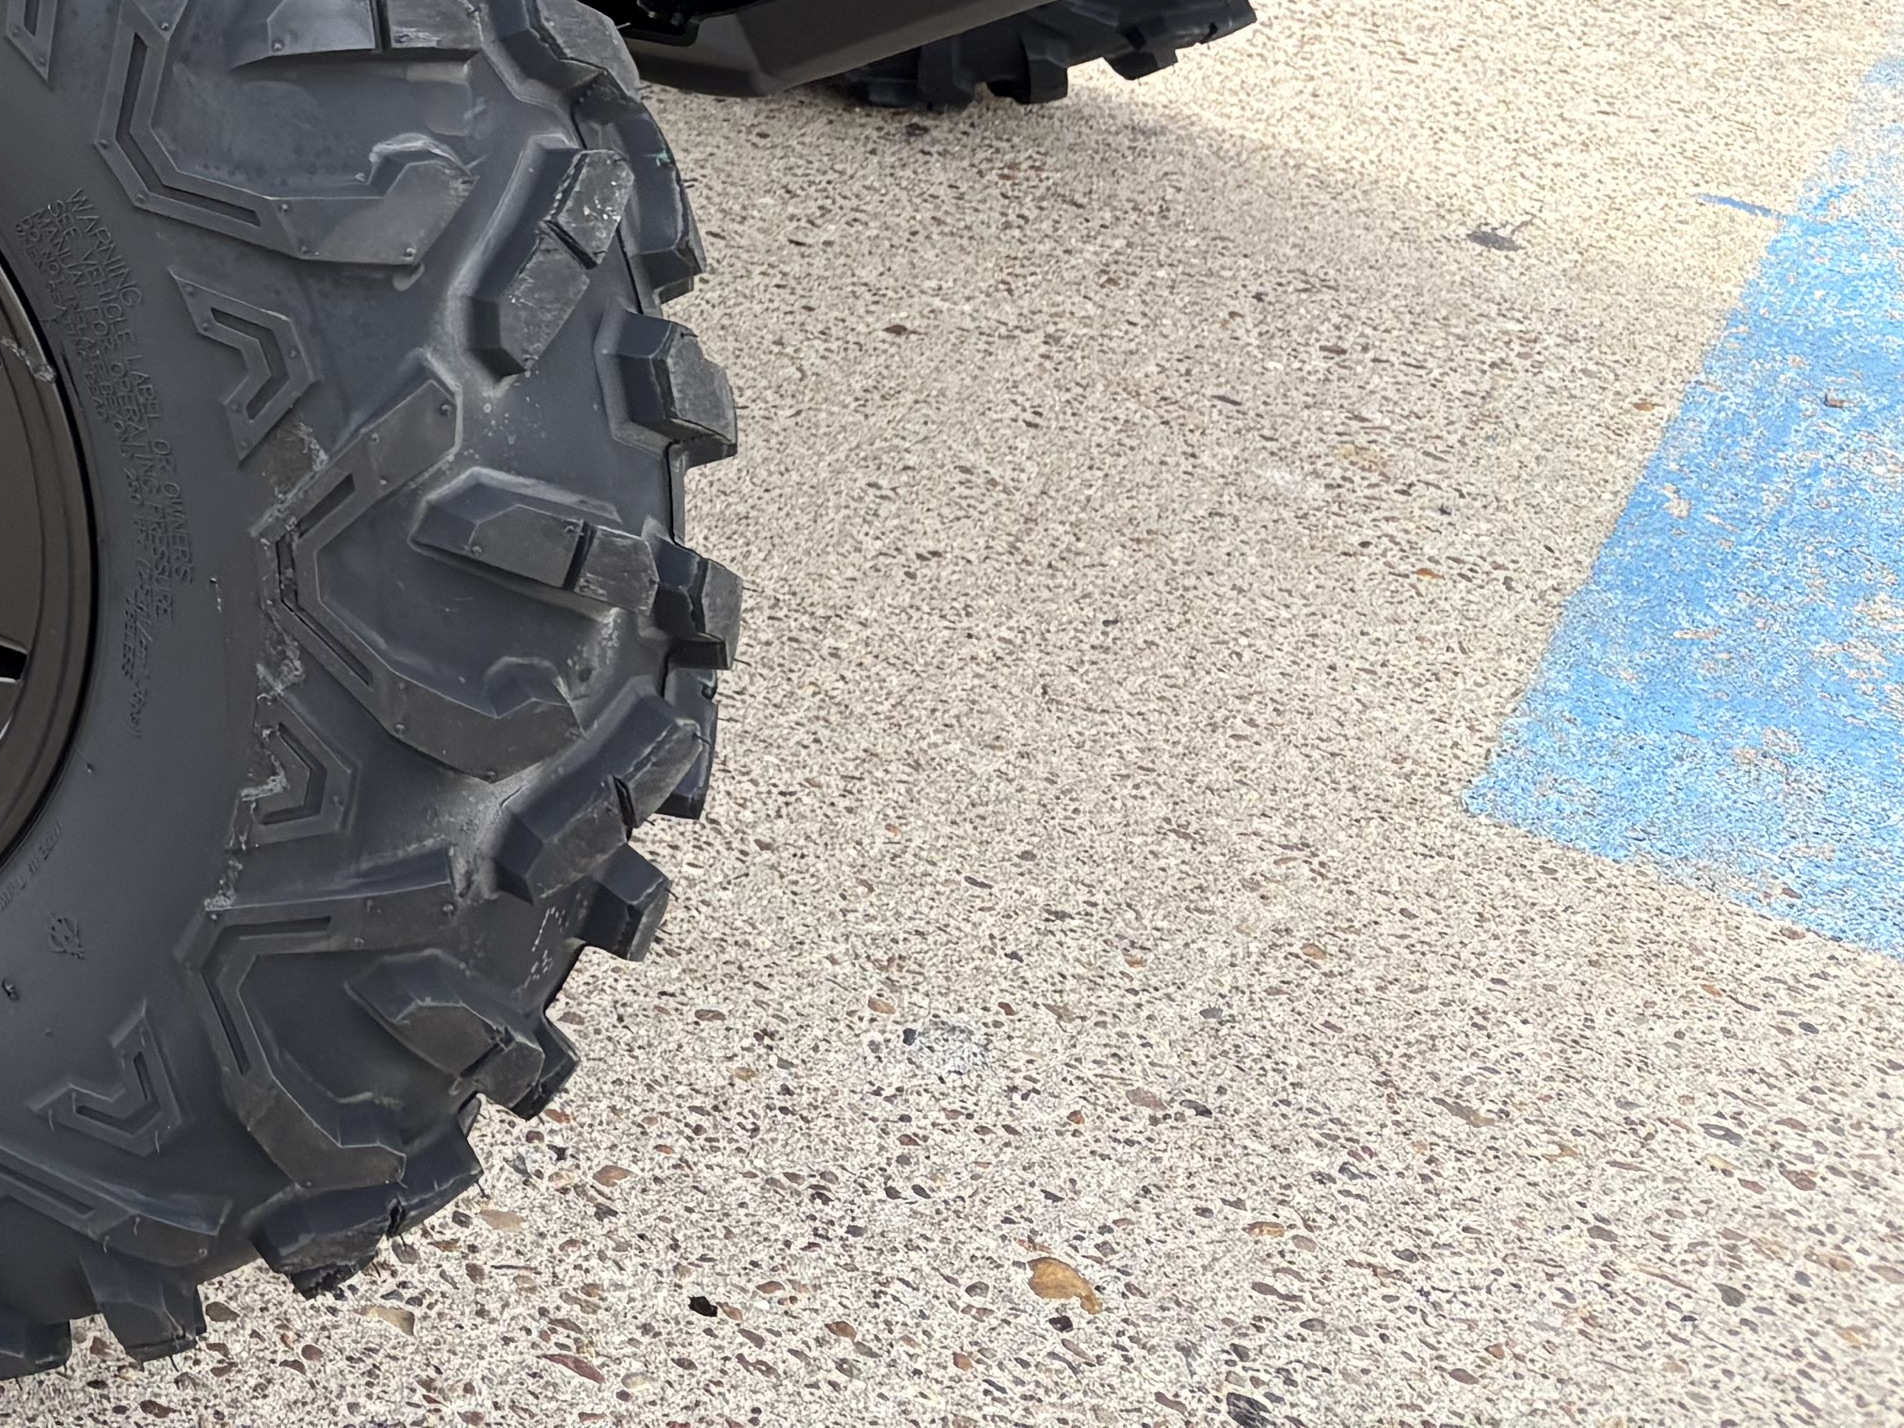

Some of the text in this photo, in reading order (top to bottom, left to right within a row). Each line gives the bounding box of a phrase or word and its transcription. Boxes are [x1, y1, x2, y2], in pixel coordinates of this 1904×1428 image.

[30, 205, 91, 296] MANUAL
[83, 304, 116, 351] FOR
[63, 185, 145, 308] WARNING
[45, 196, 84, 244] SEE
[76, 248, 136, 346] VEHICLE
[125, 354, 164, 425] LABEL
[151, 438, 176, 471] OR
